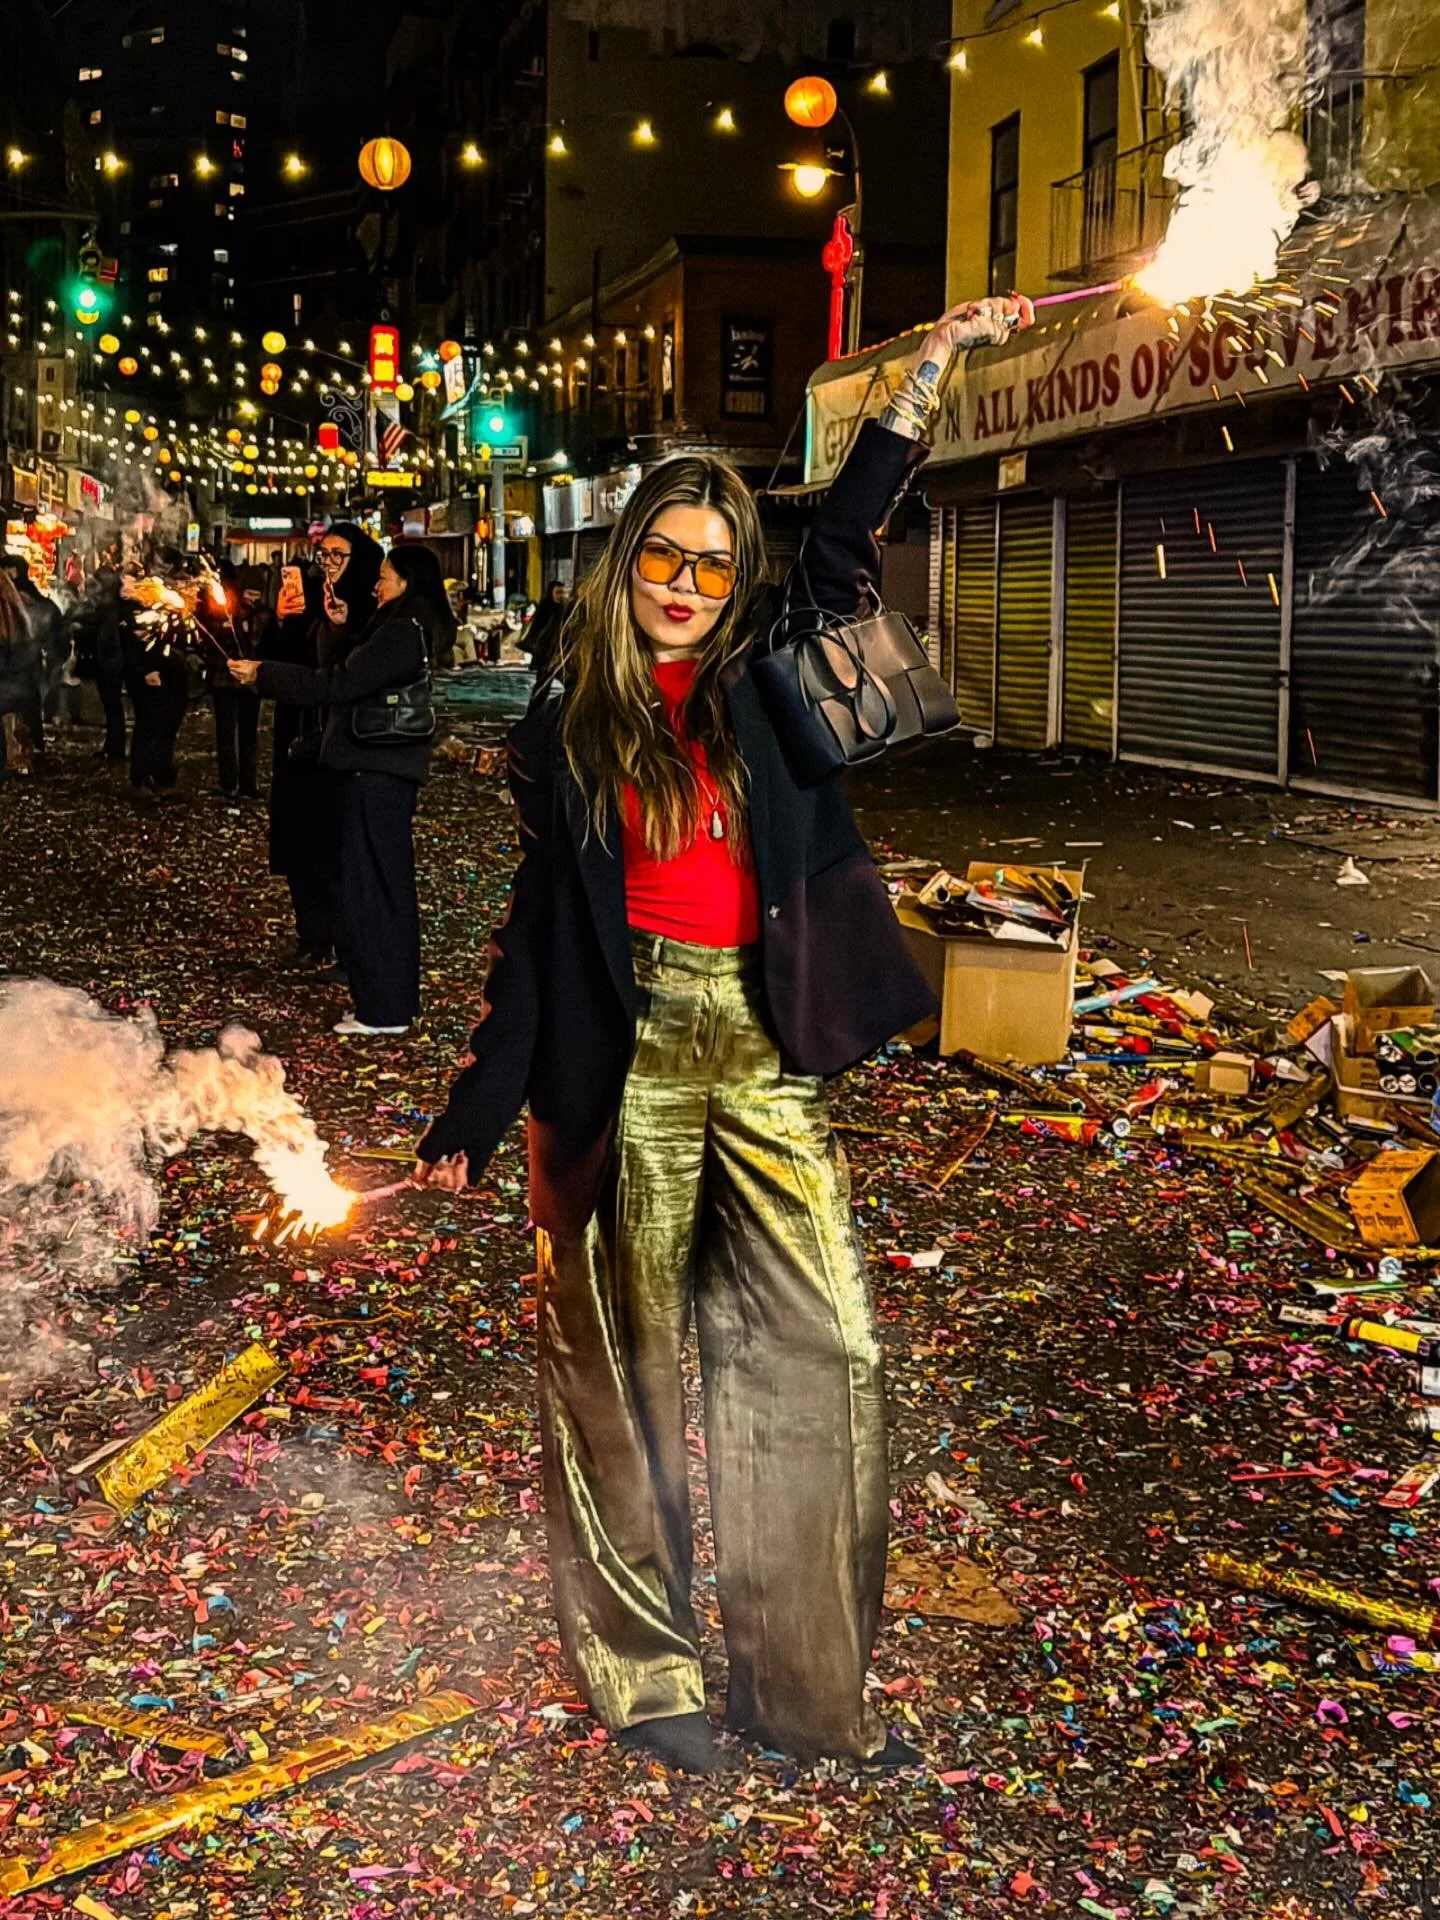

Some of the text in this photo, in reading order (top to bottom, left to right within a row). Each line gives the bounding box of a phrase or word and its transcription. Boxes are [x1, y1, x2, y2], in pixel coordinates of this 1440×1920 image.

[974, 385, 1020, 440] ALL
[1026, 353, 1121, 430] KINDS
[1131, 338, 1177, 399] OF
